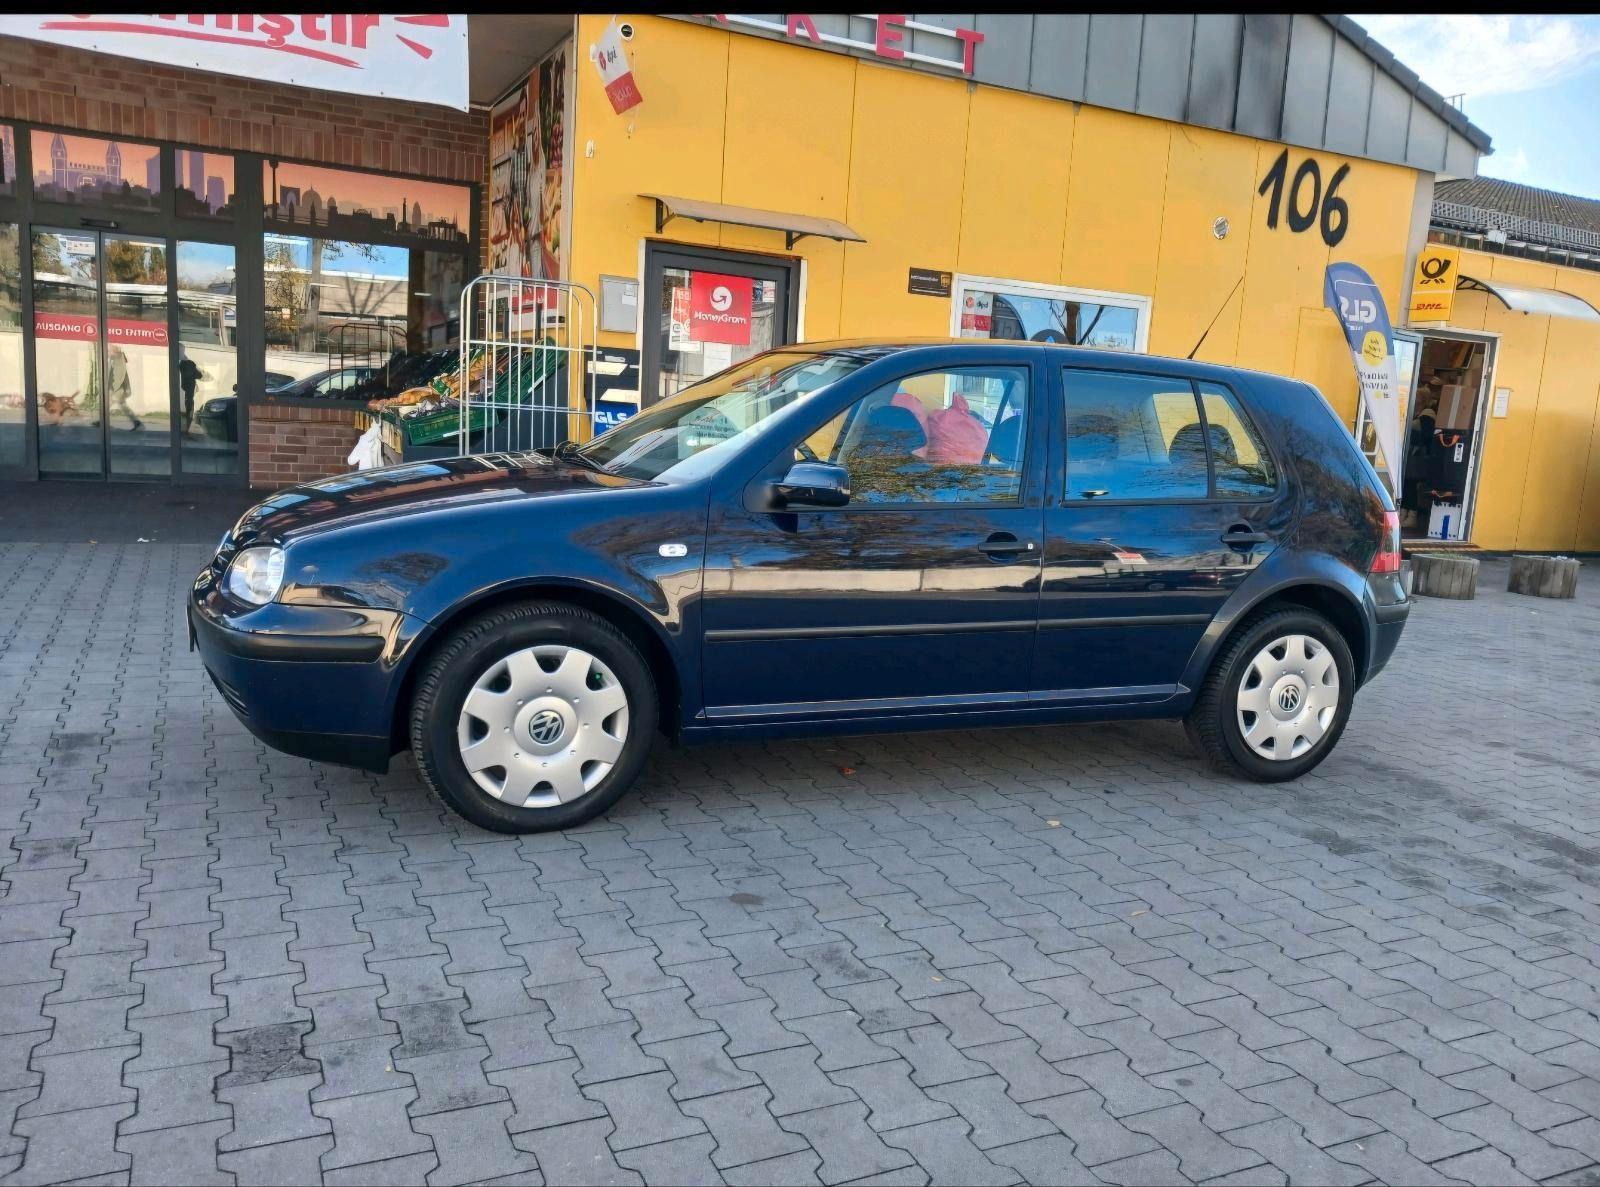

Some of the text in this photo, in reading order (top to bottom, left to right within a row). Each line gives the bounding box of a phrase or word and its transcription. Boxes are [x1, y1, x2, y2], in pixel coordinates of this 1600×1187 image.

[694, 14, 985, 75] KET
[1258, 147, 1351, 248] 106
[694, 310, 747, 325] MoneyGram
[35, 322, 81, 332] AUSGANG
[108, 328, 122, 336] NO
[595, 411, 628, 425] GLS
